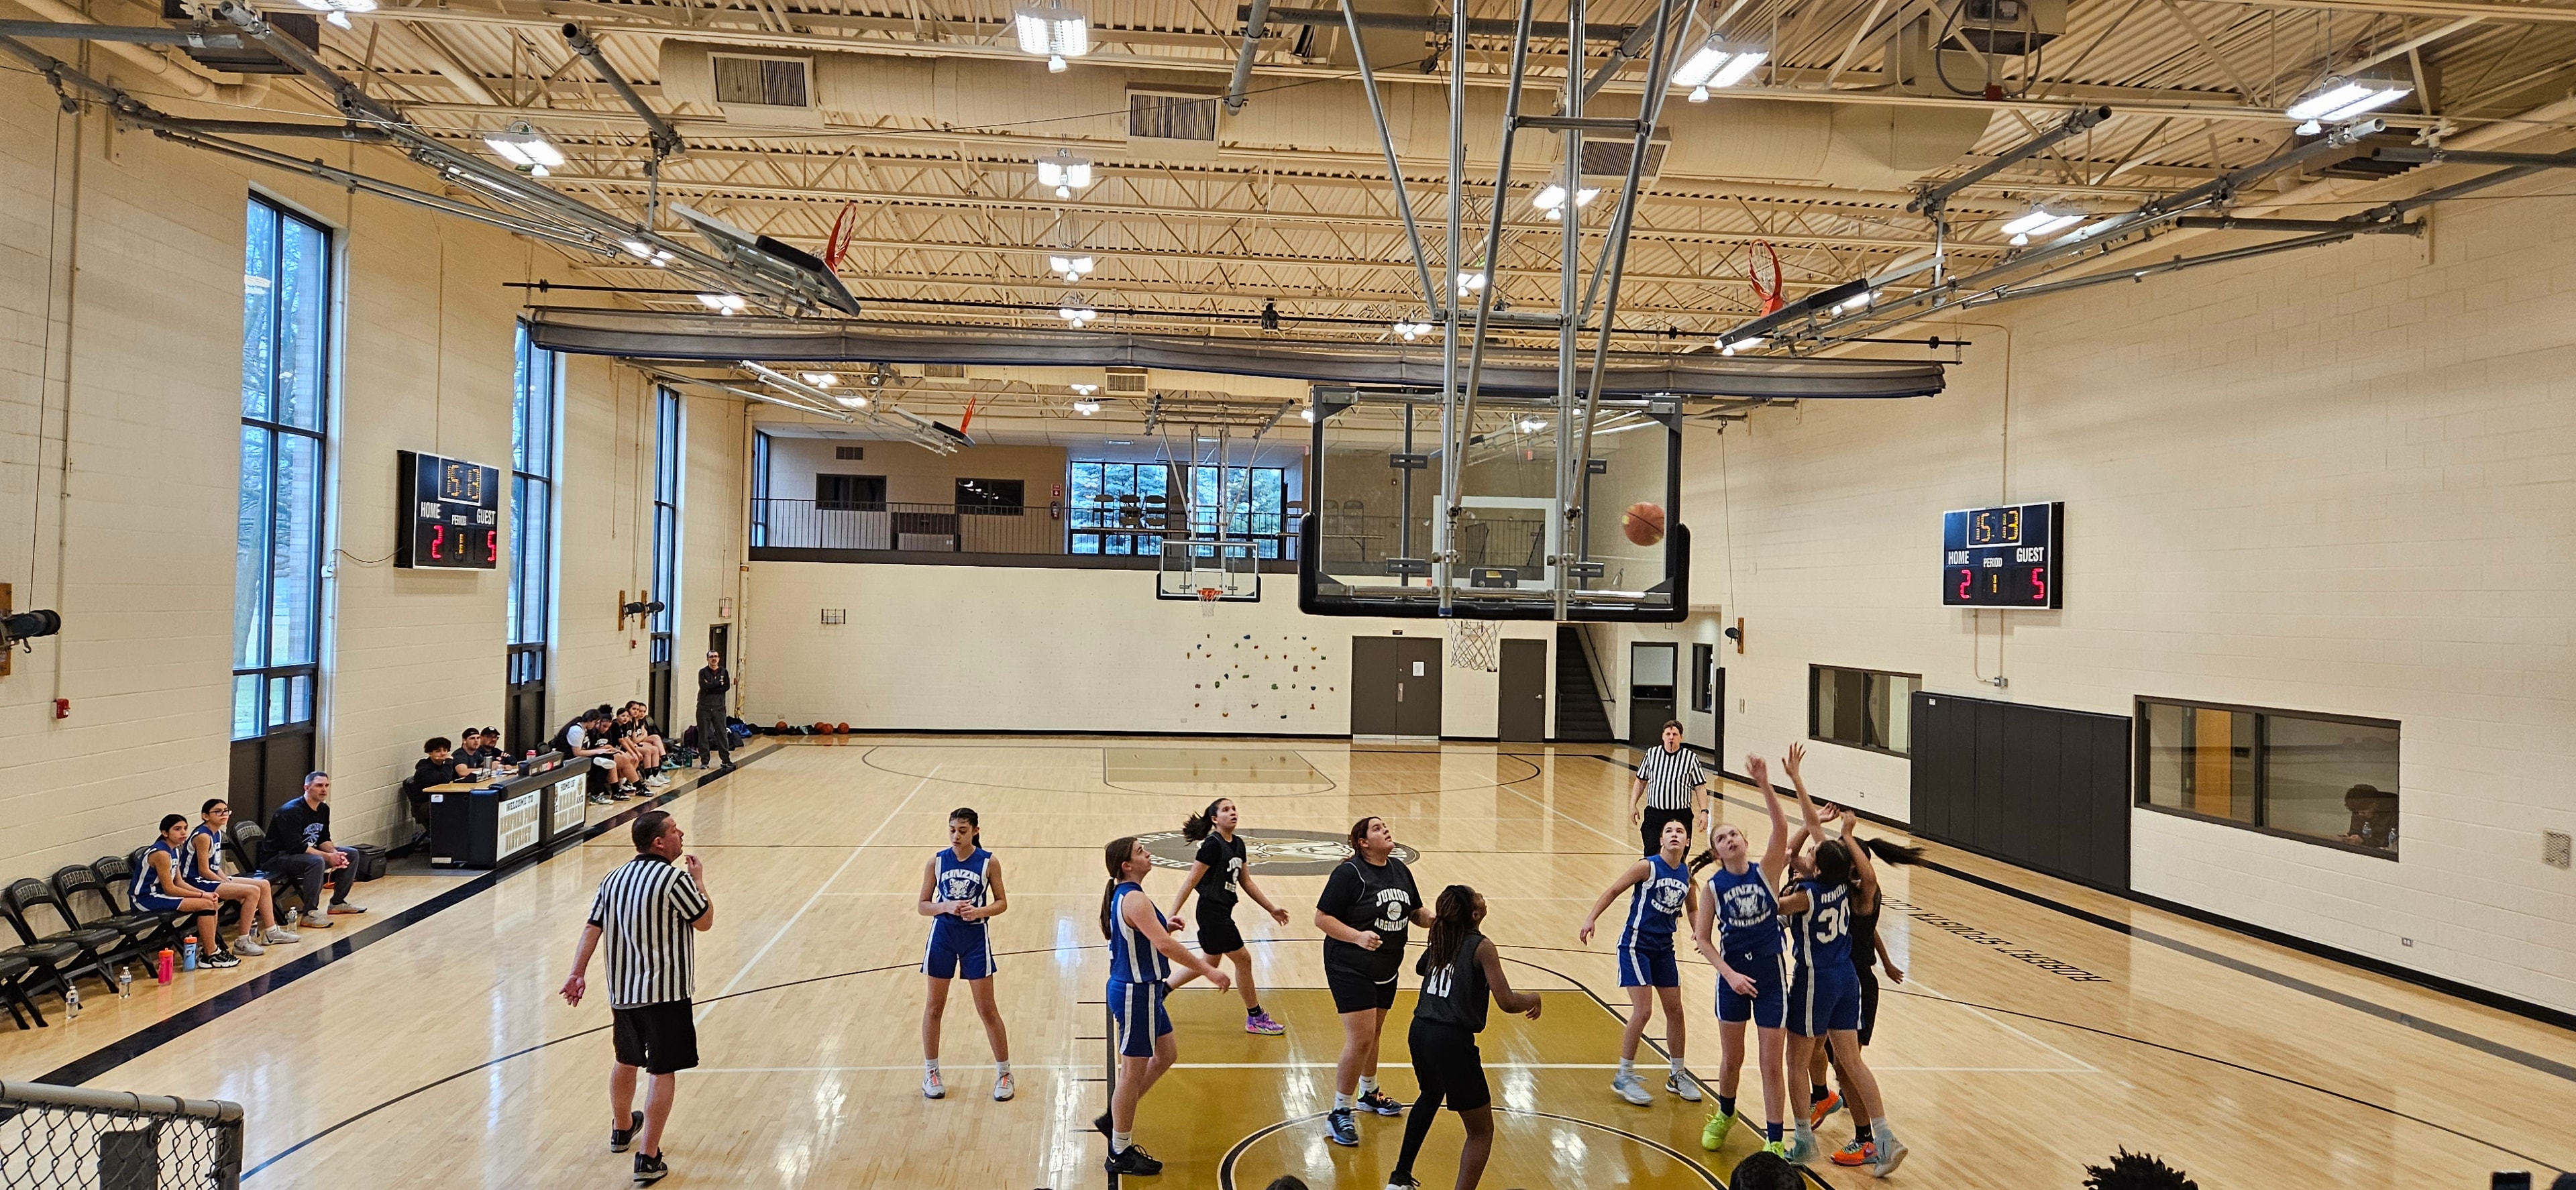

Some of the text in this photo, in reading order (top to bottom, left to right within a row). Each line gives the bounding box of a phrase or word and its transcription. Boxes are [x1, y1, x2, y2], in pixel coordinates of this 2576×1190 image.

[421, 501, 496, 526] HOME PERIOD GUEST
[432, 525, 443, 559] 2
[487, 530, 496, 562] 5
[1948, 547, 2045, 567] HOME PERIOD GUEST
[1960, 567, 2045, 599] 2 1 5
[506, 795, 533, 812] WELCOME TO
[941, 869, 981, 884] KINZIE
[1376, 888, 1411, 907] JUNIOR
[1817, 896, 1850, 944] 30
[1880, 894, 2112, 982] ROBERT SPOUSTA COU
